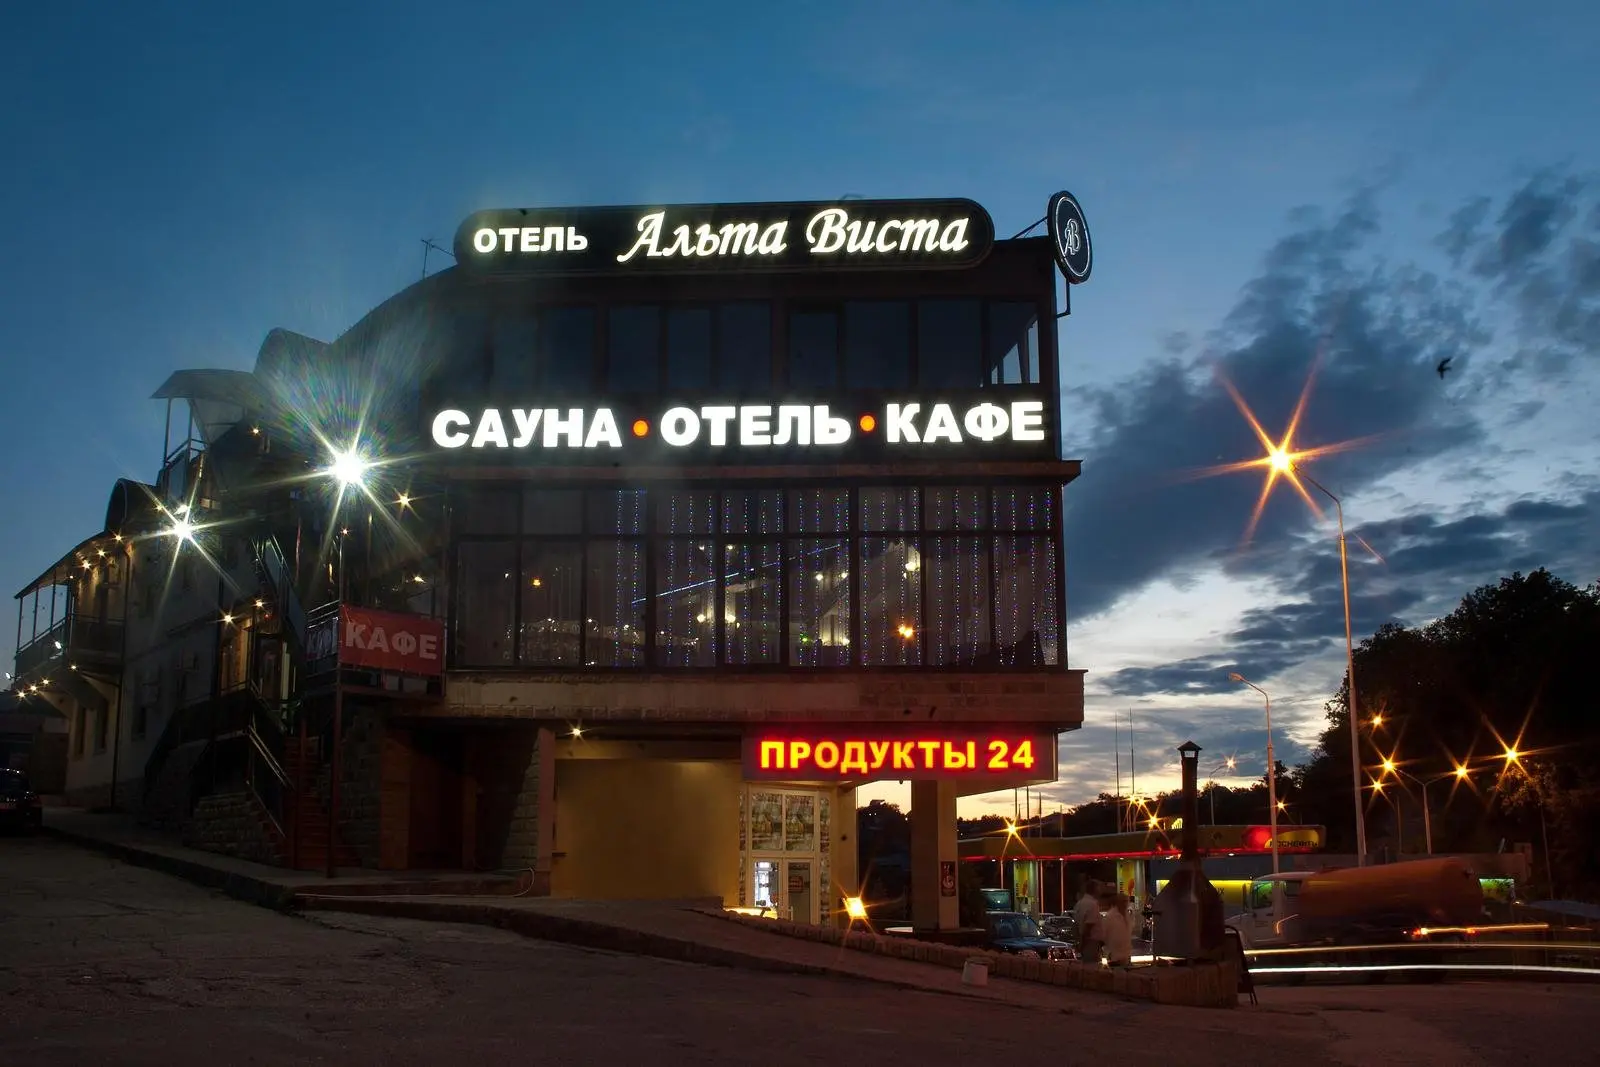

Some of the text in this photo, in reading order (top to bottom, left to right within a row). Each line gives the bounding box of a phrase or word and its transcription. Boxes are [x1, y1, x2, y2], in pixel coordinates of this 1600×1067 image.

[472, 208, 969, 263] ОТЕЛЬ Альта Виста
[431, 401, 1045, 449] САУНА ОТЕЛЬ КАФЕ
[344, 622, 438, 660] КАФЕ
[759, 740, 1035, 774] ПРОДУКТЫ 24
